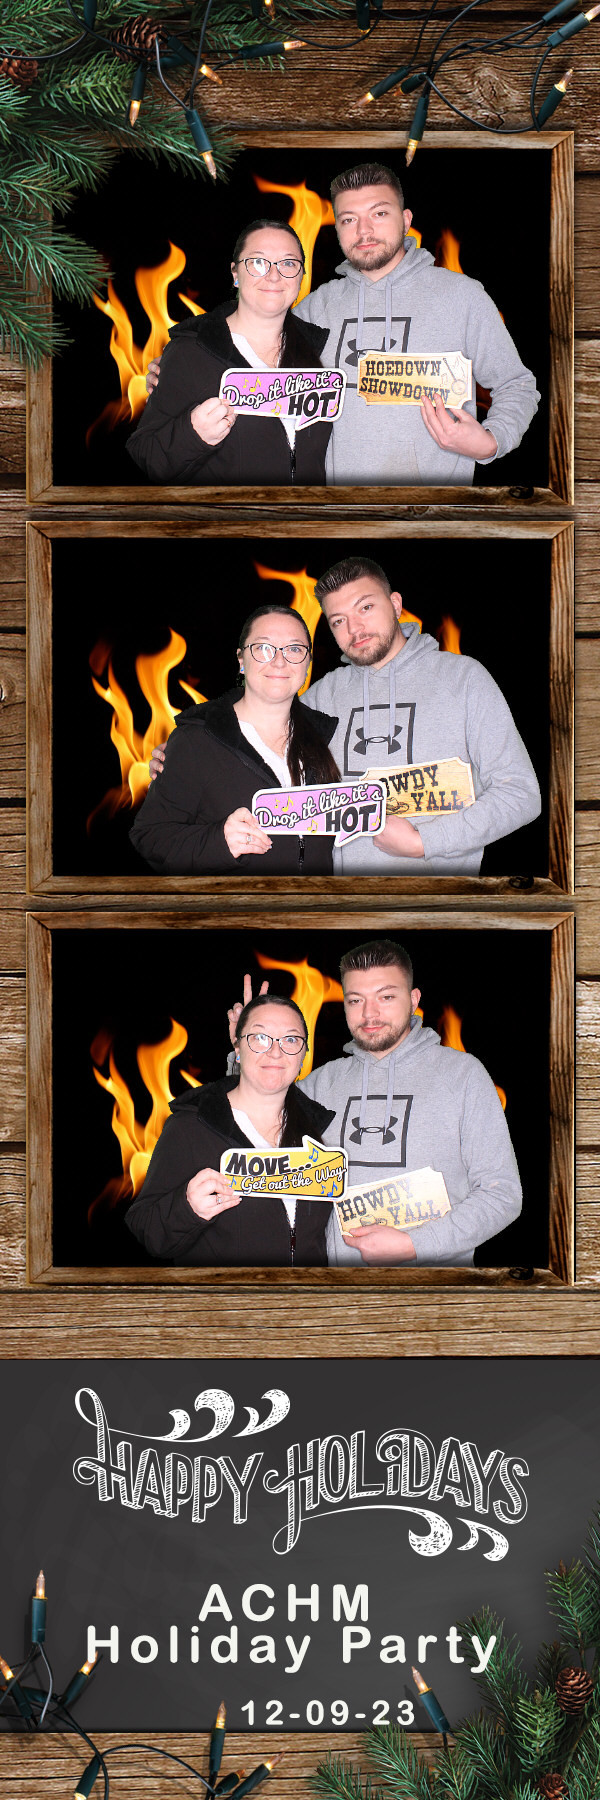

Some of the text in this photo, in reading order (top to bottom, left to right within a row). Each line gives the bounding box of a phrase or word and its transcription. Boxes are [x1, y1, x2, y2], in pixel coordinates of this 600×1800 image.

[365, 360, 442, 376] HOEDOWN
[222, 371, 344, 409] Drop it like it's
[360, 377, 450, 404] SHOWDOWN
[288, 391, 338, 418] HOT
[254, 783, 384, 829] Drop it like it's
[411, 790, 463, 811] Y'ALL
[325, 803, 377, 832] HOT
[225, 1153, 312, 1176] MOVE...
[241, 1176, 267, 1195] Get
[268, 1176, 290, 1190] out
[290, 1172, 313, 1187] the
[337, 1178, 413, 1222] HOWDY
[387, 1200, 441, 1225] Y'ALL
